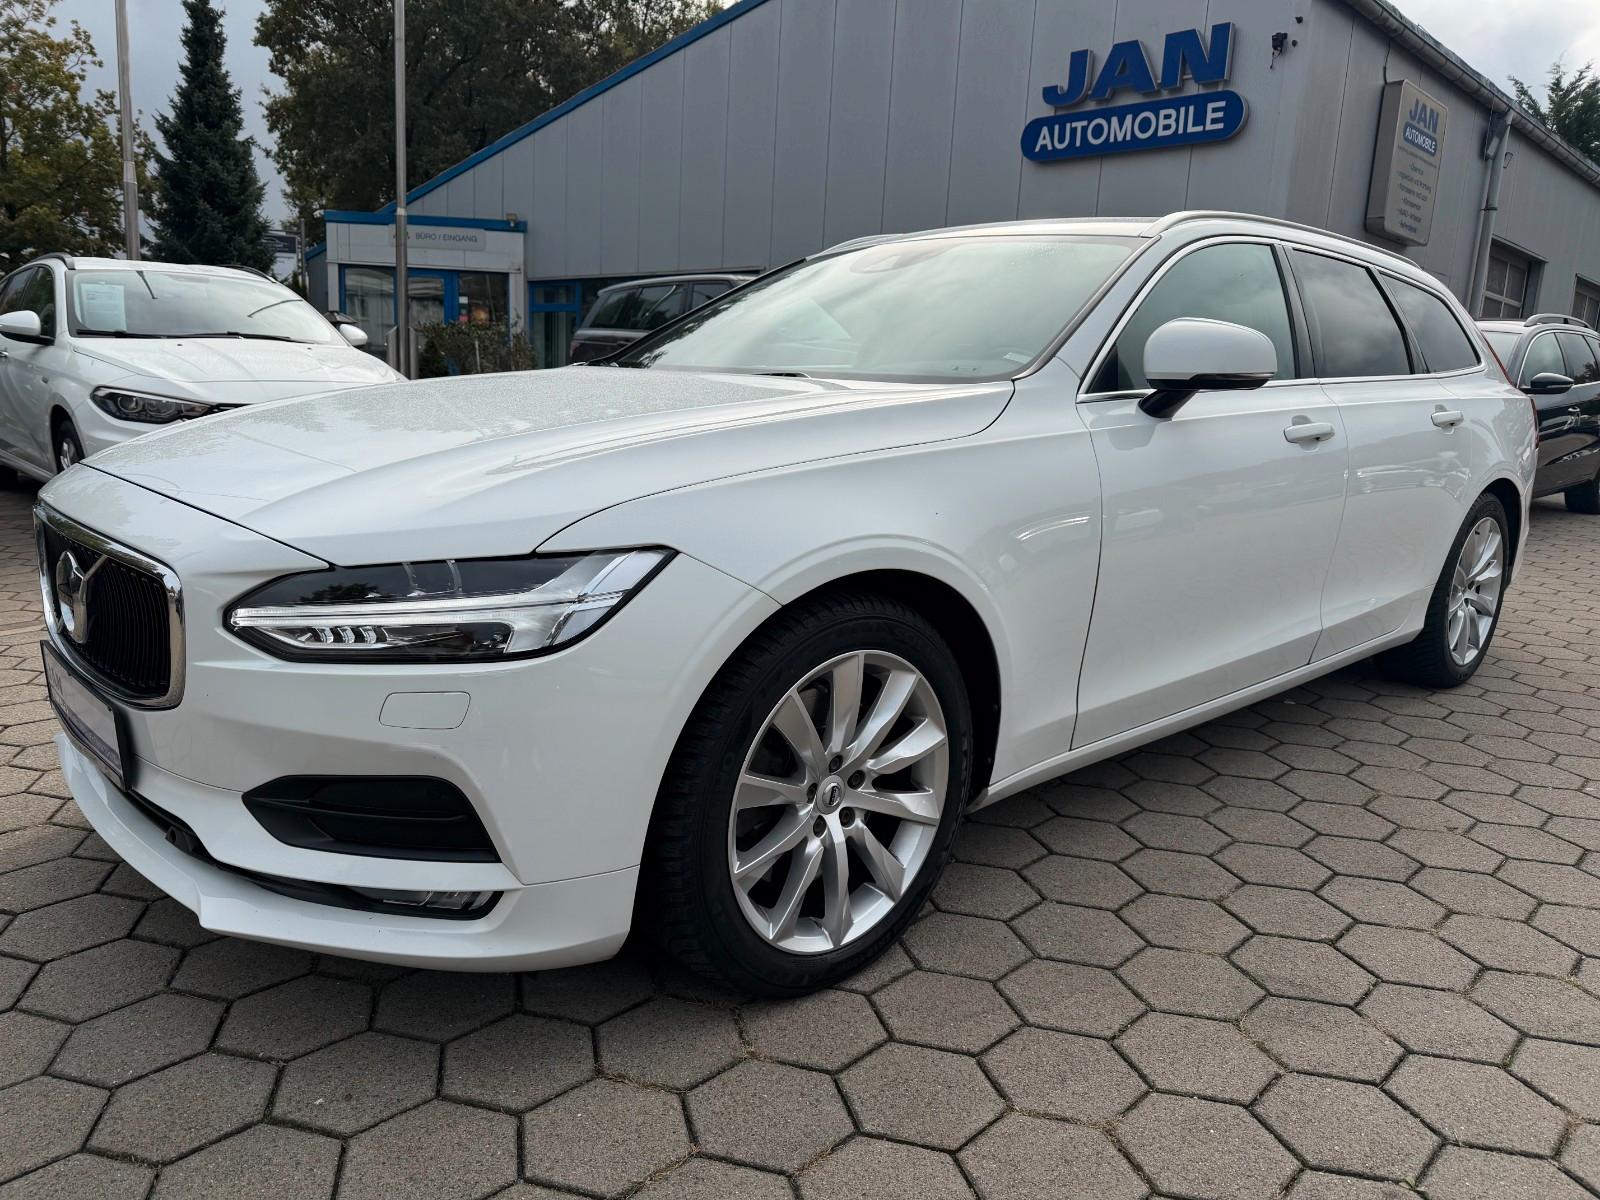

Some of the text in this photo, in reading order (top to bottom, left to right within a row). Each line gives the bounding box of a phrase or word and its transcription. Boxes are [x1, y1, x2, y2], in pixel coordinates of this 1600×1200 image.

[1042, 21, 1235, 107] JAN
[1034, 100, 1226, 152] AUTOMOBILE
[1409, 99, 1439, 133] JAN
[1405, 126, 1436, 153] AUTOMOBILE
[415, 231, 437, 241] BÜRO
[443, 233, 478, 243] EINGANG
